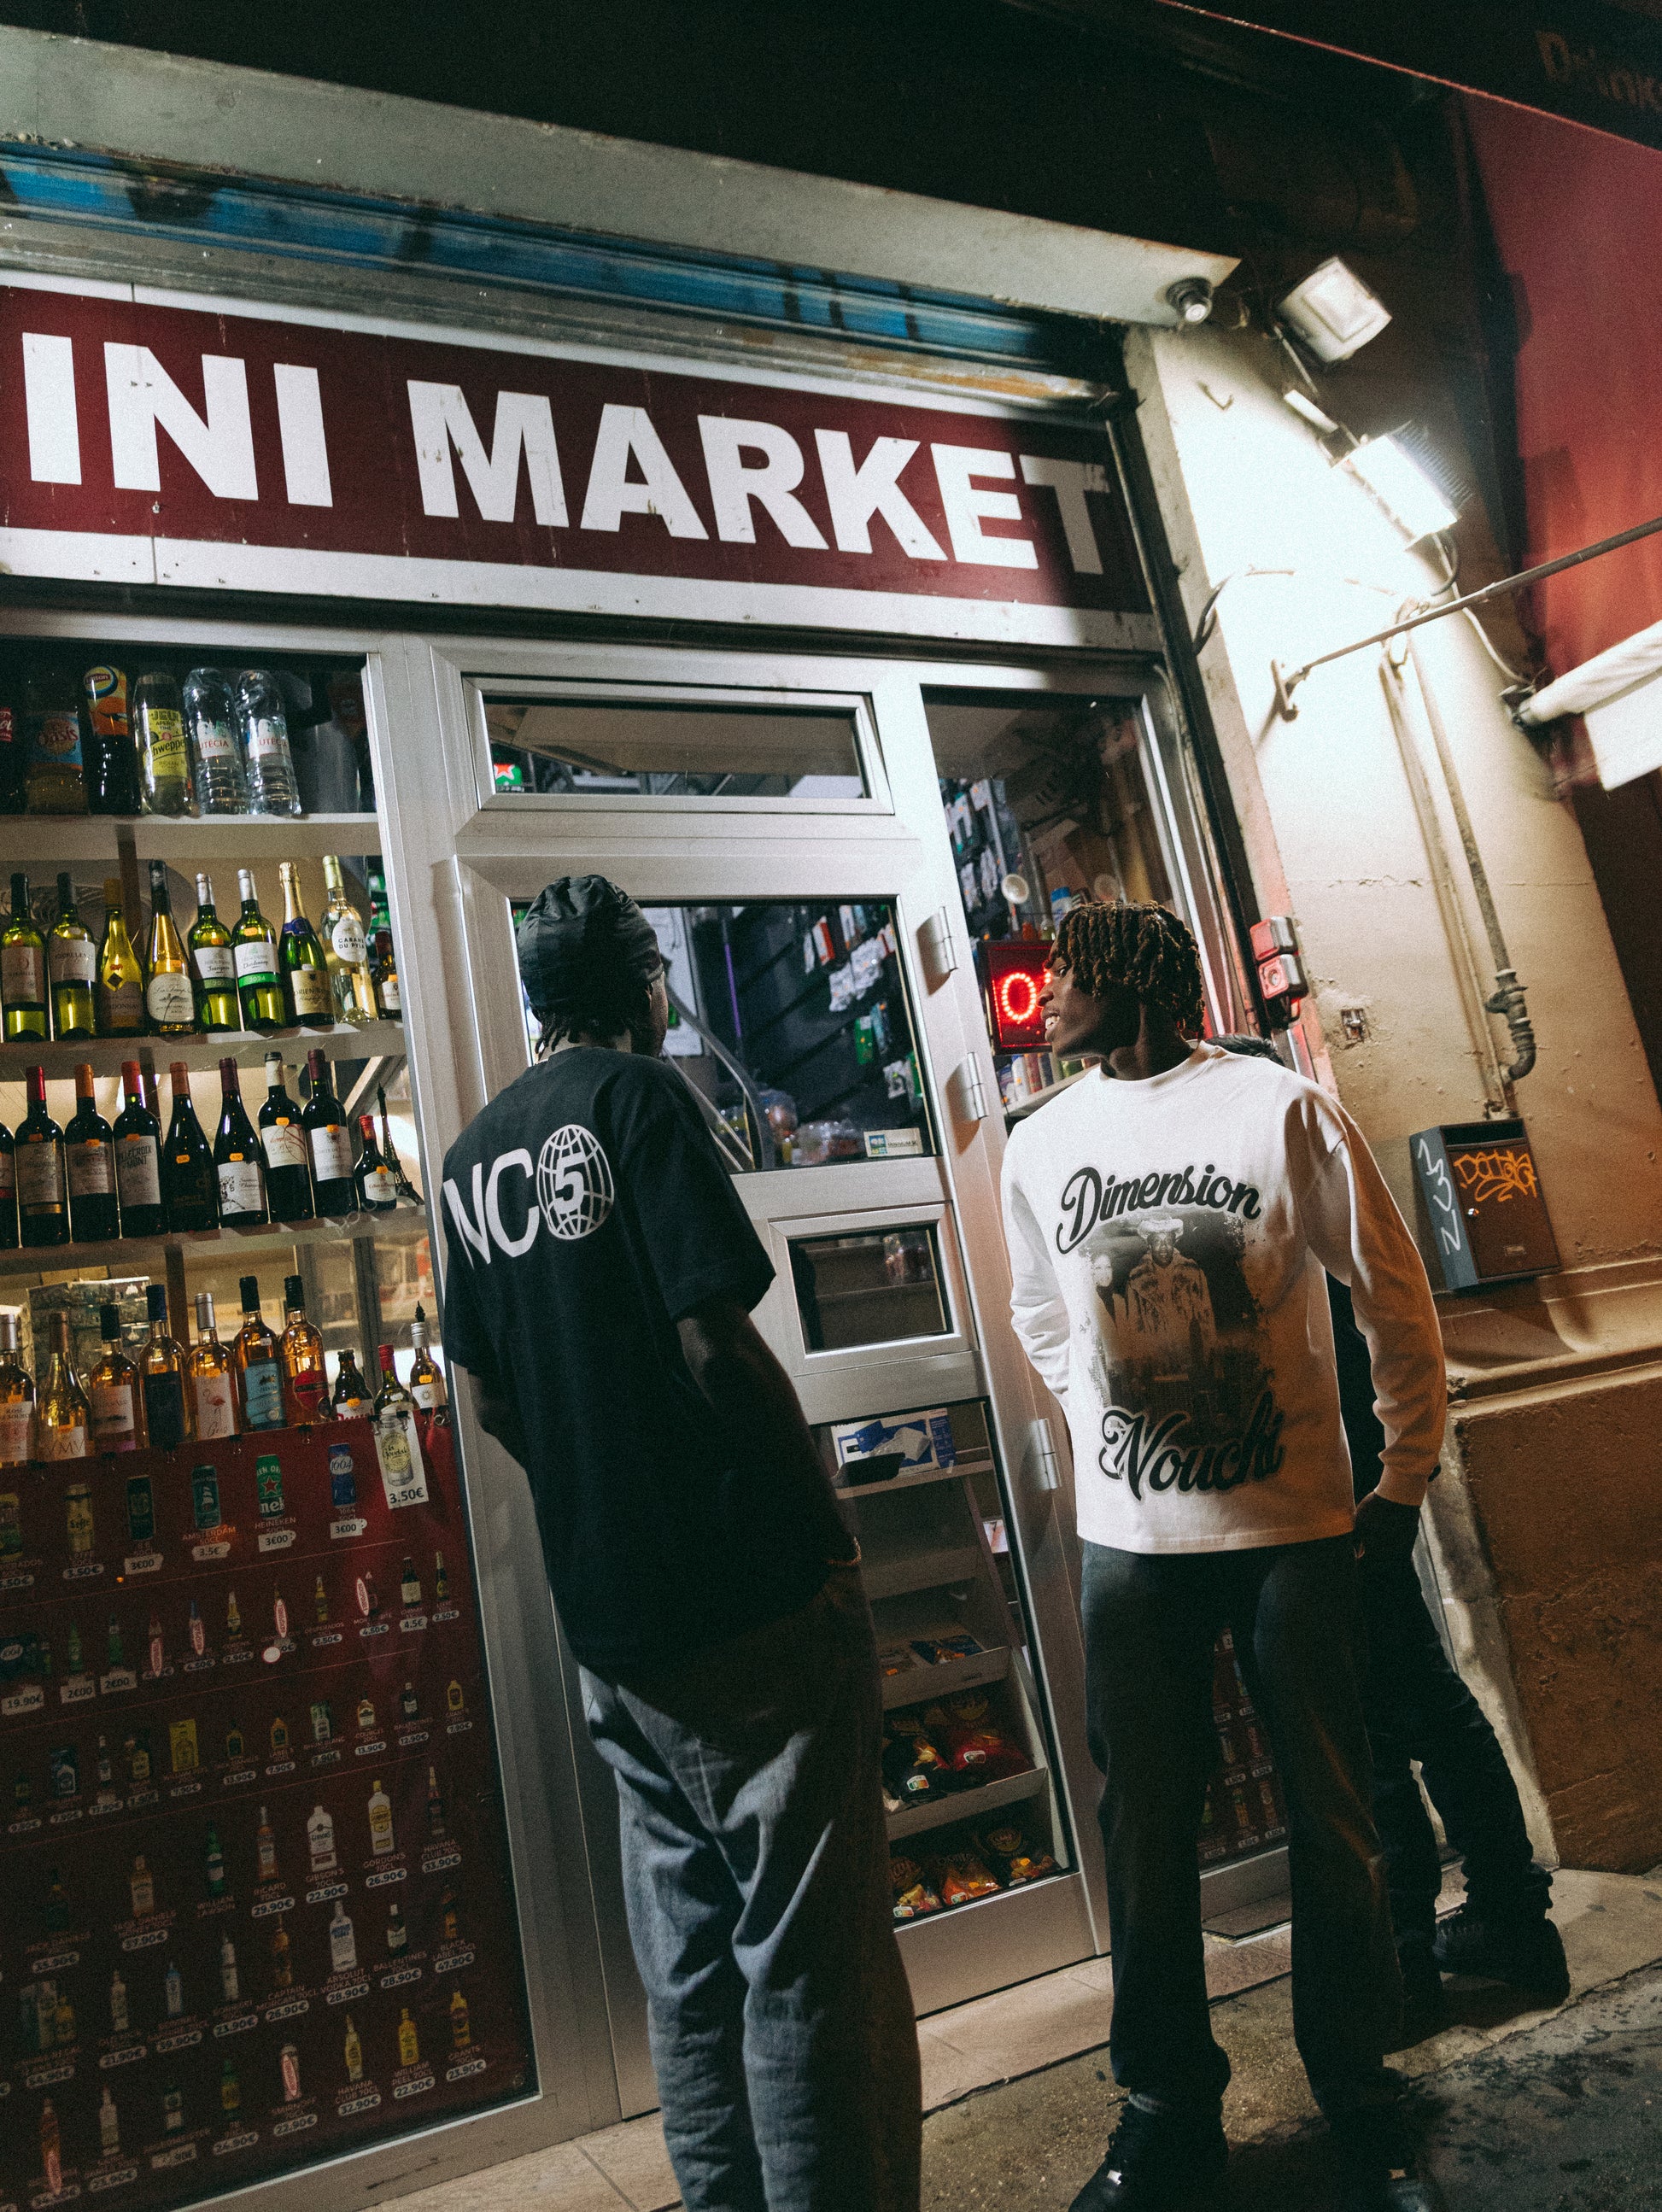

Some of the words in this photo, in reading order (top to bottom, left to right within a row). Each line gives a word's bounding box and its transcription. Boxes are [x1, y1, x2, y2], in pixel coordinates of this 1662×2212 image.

[1535, 31, 1662, 114] Drink
[22, 332, 333, 507] INI
[407, 379, 1110, 578] MARKET
[1056, 1164, 1262, 1255] Dimension
[389, 1488, 425, 1505] 3.50€
[255, 1517, 297, 1530] HEINEKEN
[335, 1524, 357, 1534] 3€00
[182, 1525, 237, 1541] AMSTERDAM
[266, 1536, 289, 1547] 3€00
[199, 1548, 221, 1558] 3.5€
[131, 1560, 155, 1571] 3€00
[404, 1618, 424, 1630] 4.5€
[8, 1694, 44, 1709] 19.90€
[423, 1839, 457, 1852] HAVANA
[363, 1852, 407, 1869] GORDON'S
[420, 1849, 442, 1861] CLUB
[367, 1870, 407, 1887] 26.90€
[253, 1881, 288, 1896] RICARD
[308, 1886, 348, 1902] 22.90€
[253, 1899, 294, 1916] 29.90€
[440, 1938, 465, 1951] BLACK
[372, 1951, 428, 1973] BALLENTINES
[436, 1953, 473, 1971] 47.90€
[319, 1981, 352, 1994] VODKA
[352, 1974, 372, 1986] 70CL
[326, 1967, 366, 1984] ABSOLUT
[382, 1969, 420, 1987] 28.90€
[267, 1985, 306, 2001] CAPTAIN
[328, 1985, 366, 2003] 28.90€
[267, 2003, 307, 2021] 26.90€
[447, 2061, 485, 2080] 23.90€
[337, 2079, 373, 2095] HAVANA
[395, 2078, 434, 2097] 22.90€
[274, 2116, 315, 2134] 22.90€
